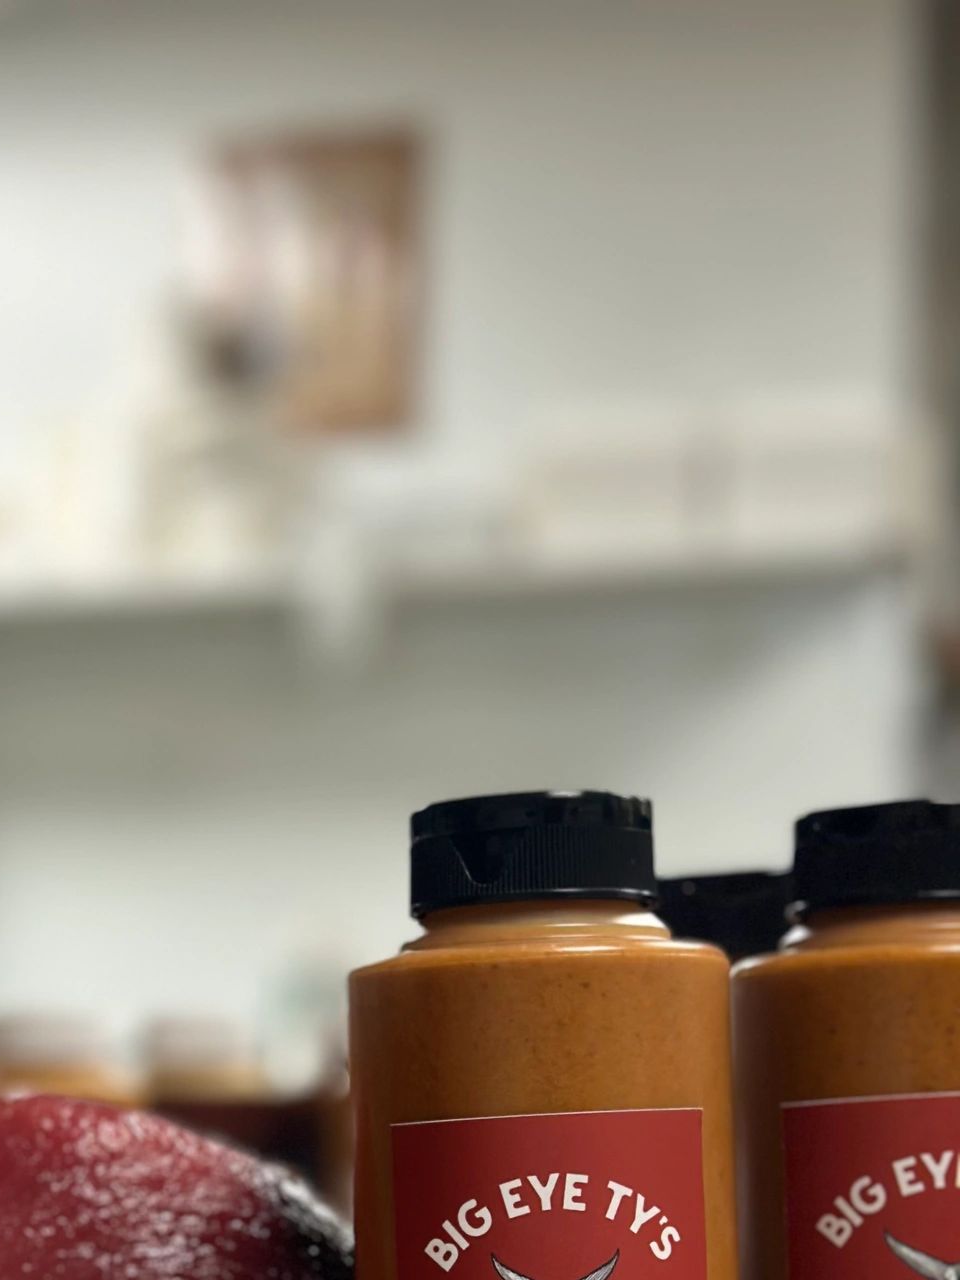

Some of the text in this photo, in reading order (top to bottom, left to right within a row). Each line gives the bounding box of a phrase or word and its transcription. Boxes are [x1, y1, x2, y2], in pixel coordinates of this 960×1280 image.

[424, 1173, 682, 1272] BIG EYE TY'S
[815, 1150, 960, 1249] BIG EY
